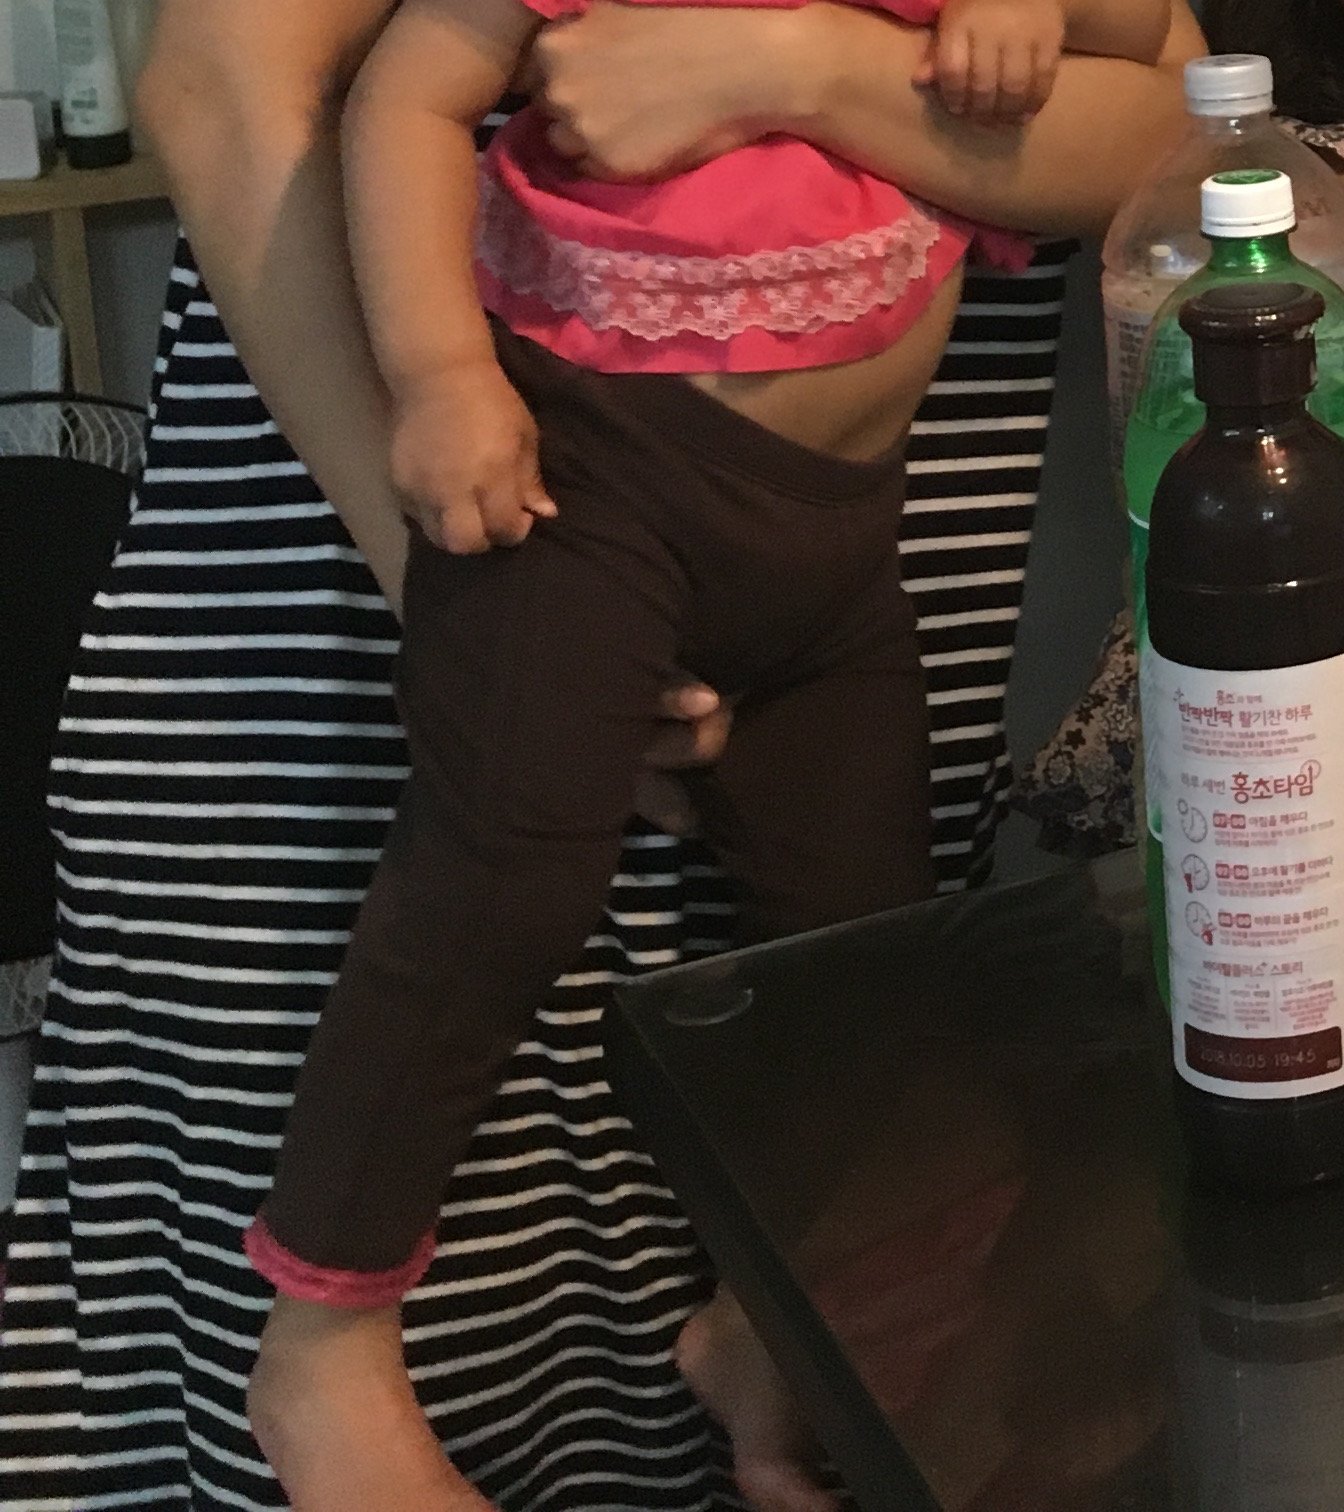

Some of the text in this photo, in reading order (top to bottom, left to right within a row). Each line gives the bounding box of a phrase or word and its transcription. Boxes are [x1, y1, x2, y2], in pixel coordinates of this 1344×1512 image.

[1178, 703, 1313, 727] 반짝반짝 활기찬 하루
[1230, 768, 1316, 805] 홍초타임
[1270, 961, 1303, 974] 스토리
[1273, 1047, 1317, 1068] 19:45
